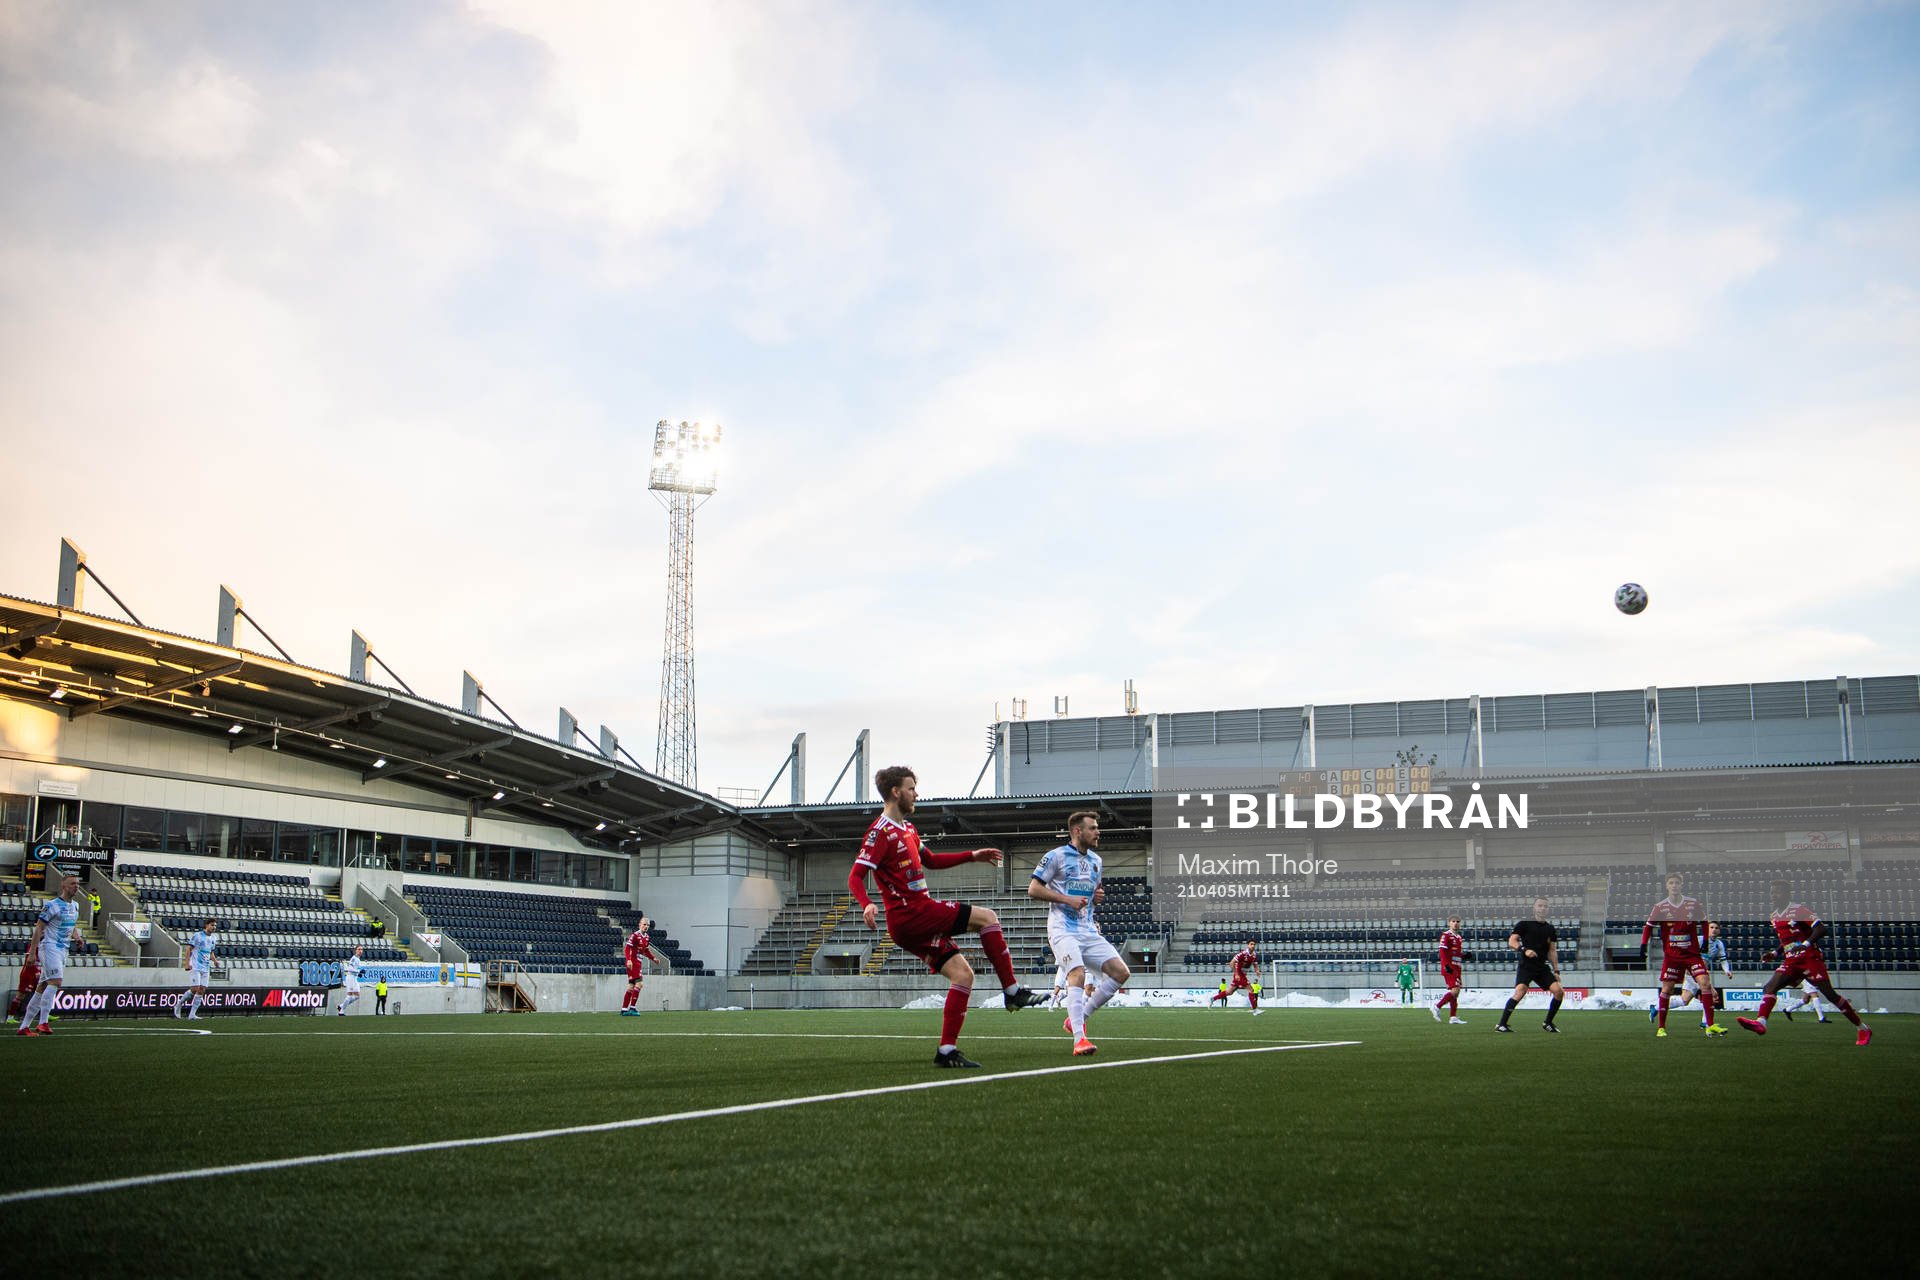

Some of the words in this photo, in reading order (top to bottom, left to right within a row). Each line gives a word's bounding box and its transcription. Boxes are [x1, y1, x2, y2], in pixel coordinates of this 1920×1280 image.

[1330, 772, 1338, 782] A
[1364, 770, 1371, 780] C
[1400, 768, 1406, 779] E
[1330, 784, 1338, 794] B
[1364, 784, 1372, 794] D
[300, 961, 341, 986] 1882
[116, 991, 157, 1007] GÄVLE
[225, 993, 257, 1007] MORA
[262, 989, 325, 1008] AllKontor
[1732, 992, 1753, 1000] Gefle
